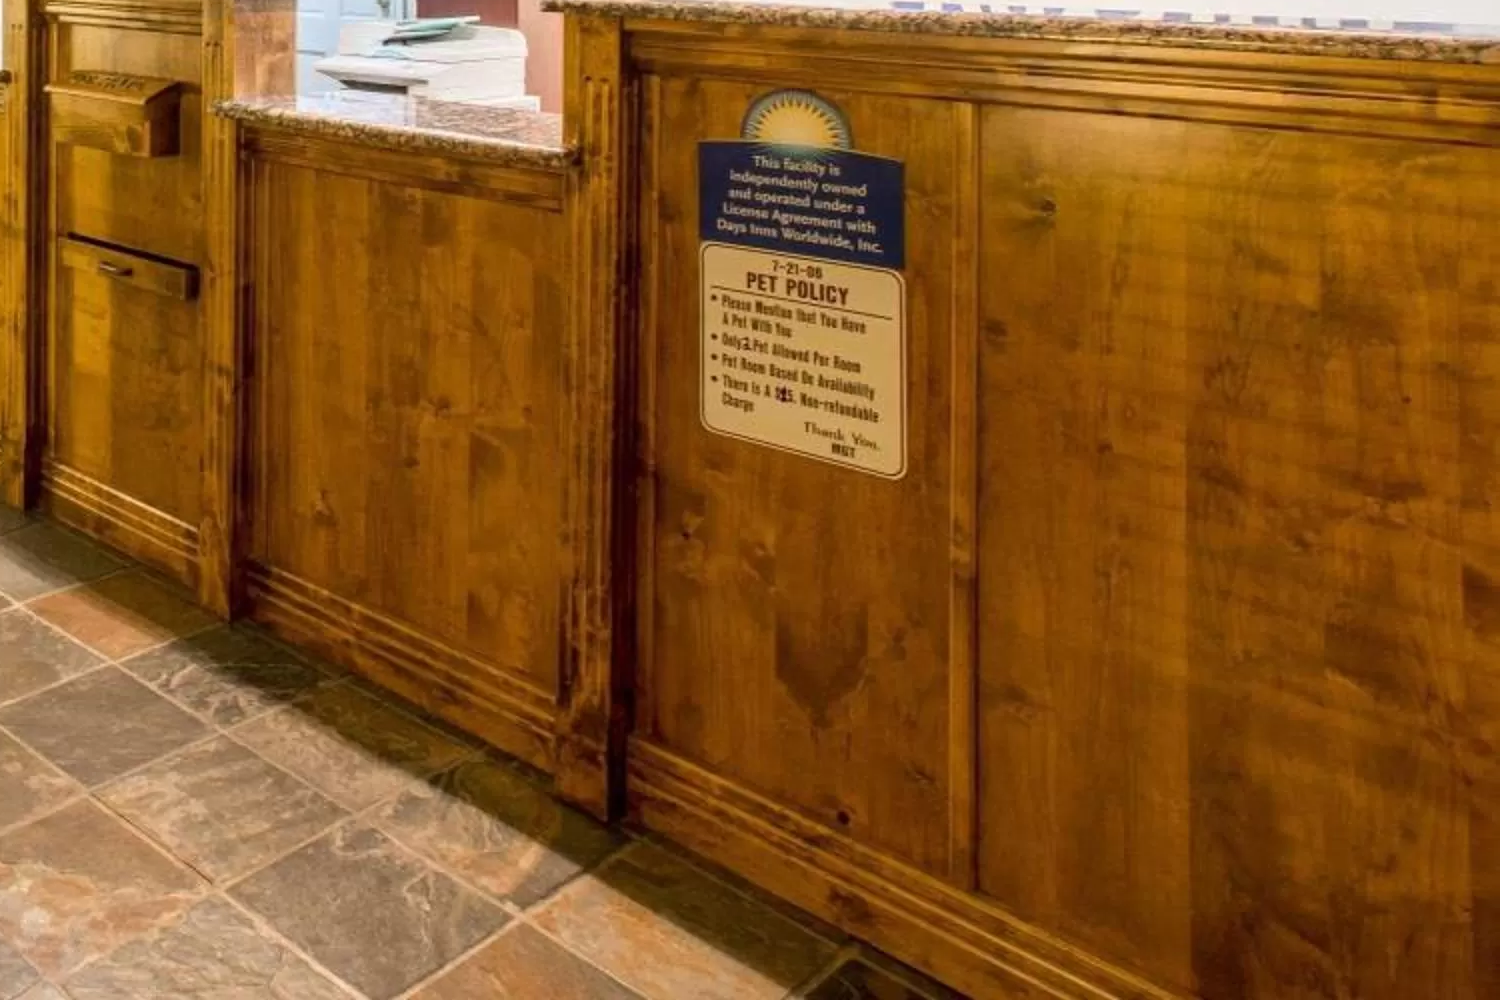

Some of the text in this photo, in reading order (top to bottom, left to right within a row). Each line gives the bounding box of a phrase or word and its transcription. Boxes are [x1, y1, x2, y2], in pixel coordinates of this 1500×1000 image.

[753, 155, 841, 177] This facility is
[729, 168, 868, 197] independently owned
[728, 187, 865, 215] and operated under a
[722, 202, 877, 234] License Agreement with
[716, 217, 884, 254] Days Inns Worldwide, Inc.
[746, 271, 850, 306] PET POLICY
[722, 294, 752, 311] Please
[755, 300, 793, 319] Mention
[820, 311, 838, 329] You
[841, 317, 867, 335] Have
[722, 312, 793, 338] A Pet With You
[753, 339, 769, 355] Pet
[771, 343, 810, 364] Allowed
[813, 351, 830, 367] Per
[833, 355, 862, 373] Room
[722, 353, 737, 369] Pet
[740, 357, 766, 375] Room
[769, 363, 799, 382] Based
[817, 374, 876, 401] Availability
[721, 391, 755, 413] Charge
[722, 374, 749, 392] There
[764, 385, 772, 398] A
[800, 391, 881, 424] Non-refundable
[804, 421, 845, 441] Thank
[831, 442, 856, 459] MGT
